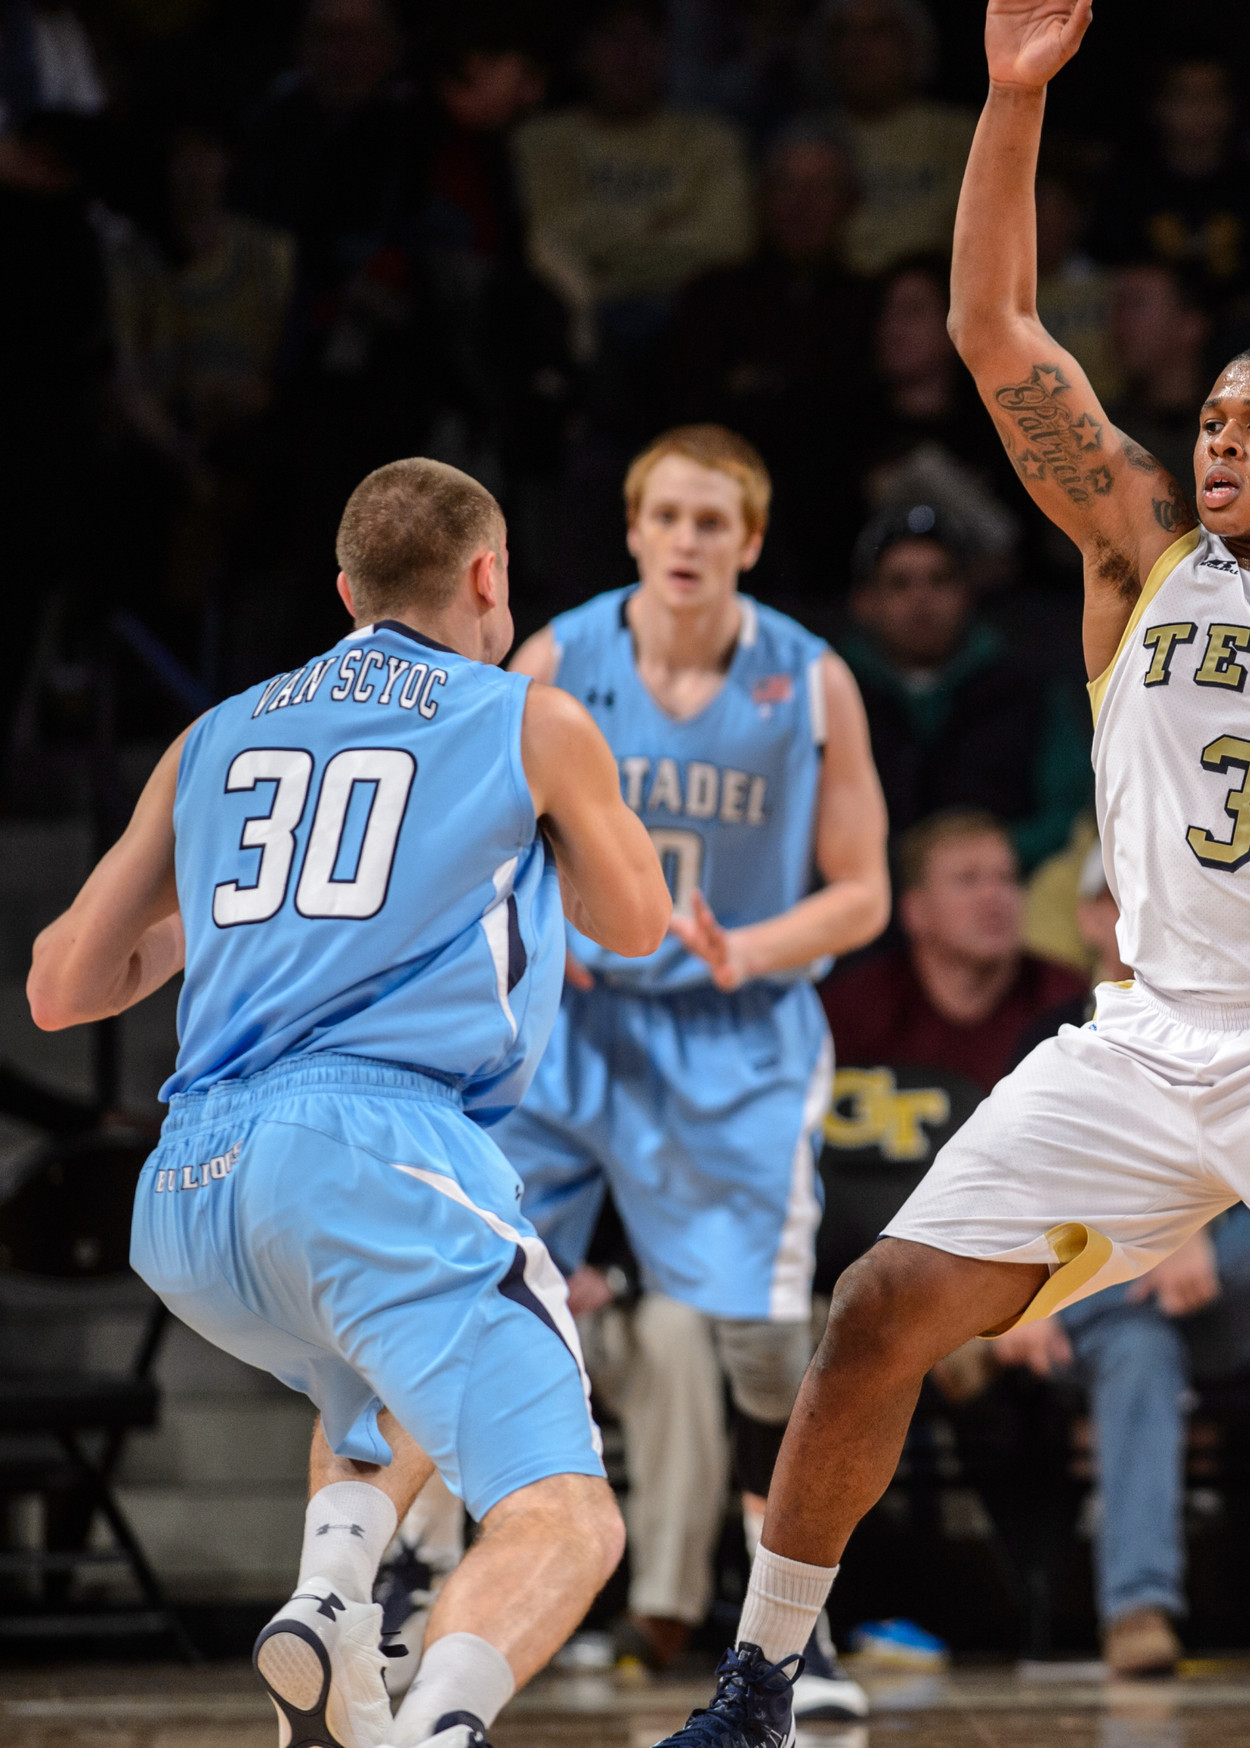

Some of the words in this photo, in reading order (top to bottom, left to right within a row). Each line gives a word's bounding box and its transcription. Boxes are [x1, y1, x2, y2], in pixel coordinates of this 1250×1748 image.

[252, 655, 338, 719] VAN
[330, 649, 448, 720] SCYOC
[616, 756, 769, 827] TADEL
[212, 748, 417, 929] 30
